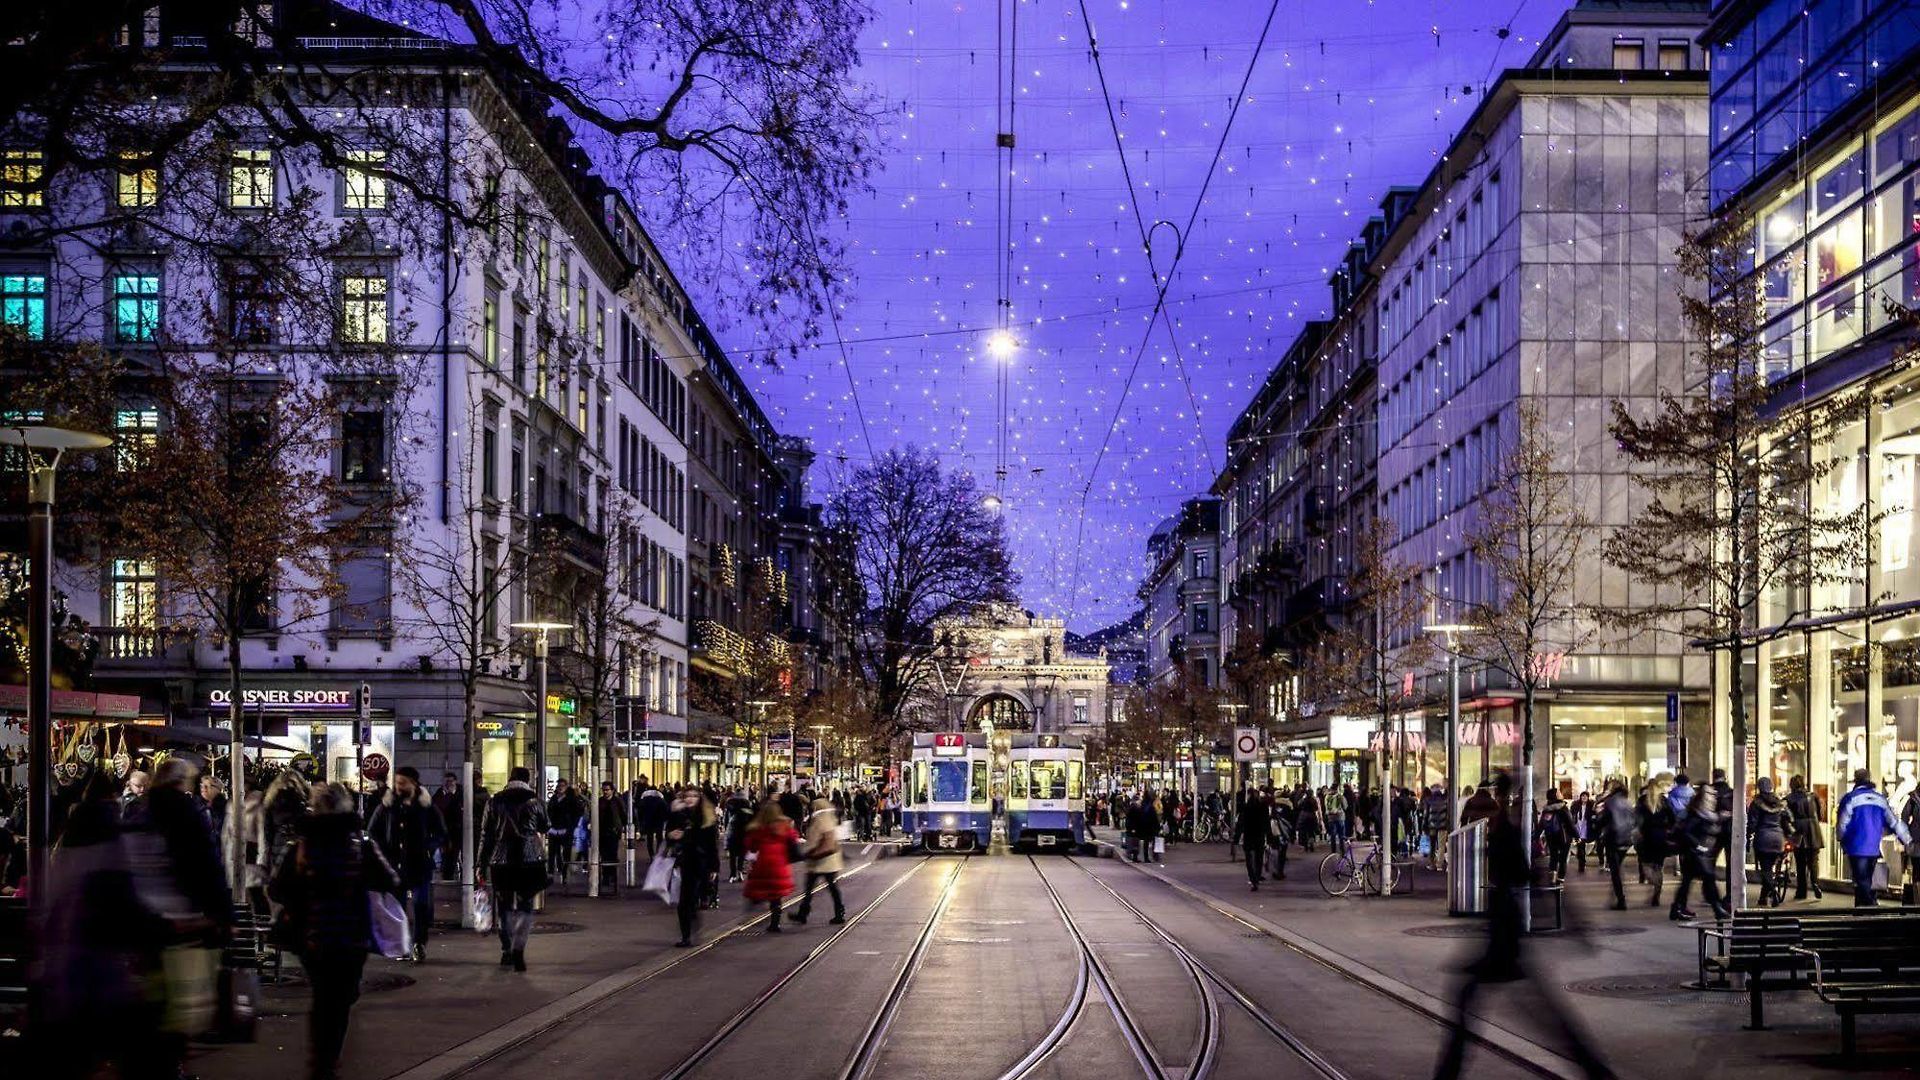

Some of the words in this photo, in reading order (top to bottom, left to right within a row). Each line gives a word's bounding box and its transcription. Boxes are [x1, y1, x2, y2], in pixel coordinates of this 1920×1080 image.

[293, 690, 350, 703] SPORT
[488, 729, 515, 738] vitality
[942, 735, 957, 746] 17
[1044, 736, 1054, 747] 7
[364, 757, 389, 770] 50%
